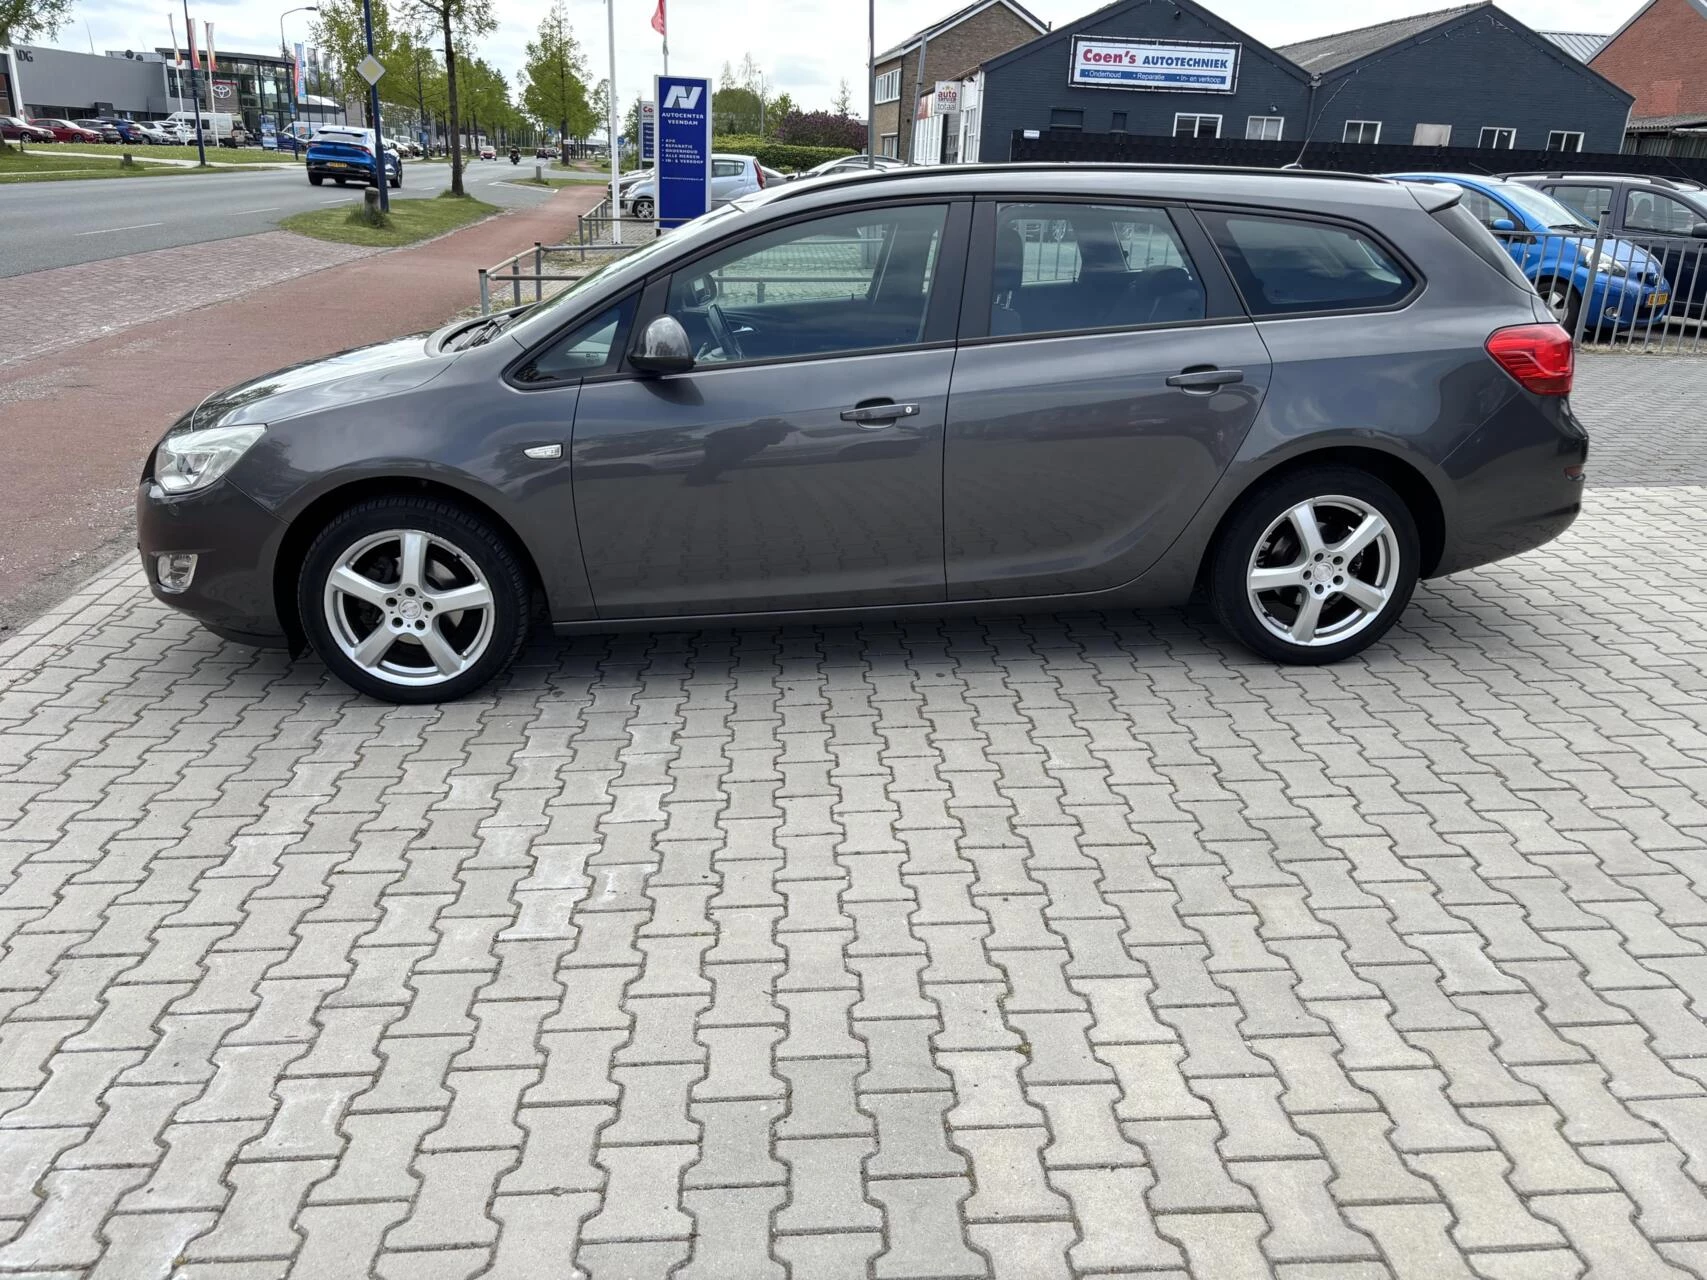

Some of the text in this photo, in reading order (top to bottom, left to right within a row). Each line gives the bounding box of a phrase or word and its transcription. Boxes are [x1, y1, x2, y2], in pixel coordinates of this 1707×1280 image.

[1083, 48, 1229, 69] Coen's AUTOTECHNIEK
[1089, 70, 1122, 78] Onderhoud
[1137, 72, 1165, 81] Reparatie
[1198, 76, 1222, 84] verkoop
